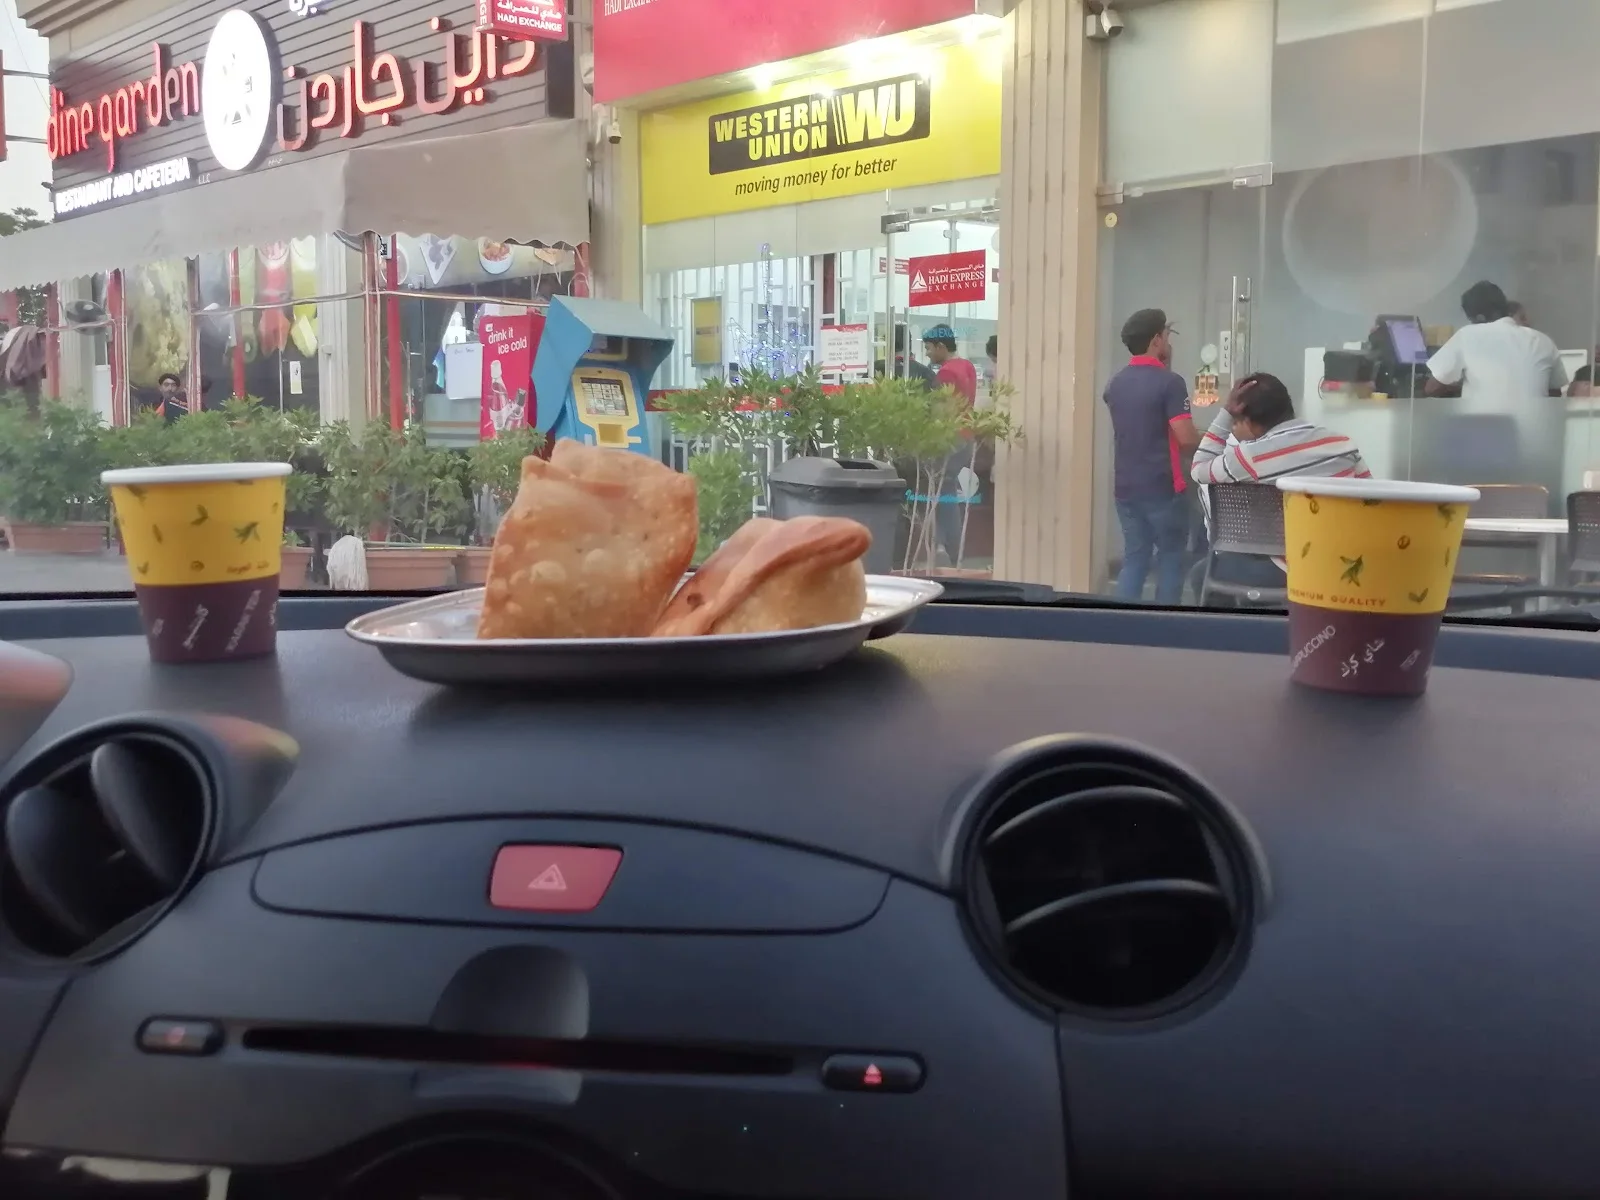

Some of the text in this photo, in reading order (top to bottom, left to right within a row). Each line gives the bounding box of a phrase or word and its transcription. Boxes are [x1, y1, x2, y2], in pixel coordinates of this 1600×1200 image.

[497, 12, 562, 32] HADI EXCHANGE
[277, 20, 404, 151] جاردن
[47, 41, 199, 173] dine garden
[714, 99, 828, 143] WESTERN
[841, 79, 916, 144] WU
[748, 124, 828, 161] UNION
[113, 172, 133, 198] AND
[134, 157, 190, 193] CAFETERIA
[735, 157, 898, 196] moving money for better
[928, 270, 985, 285] HADI EXPRESS
[928, 280, 984, 293] EXCHANGE
[488, 326, 514, 345] drink it
[497, 335, 528, 355] ice cold
[1330, 595, 1386, 607] QUALITY
